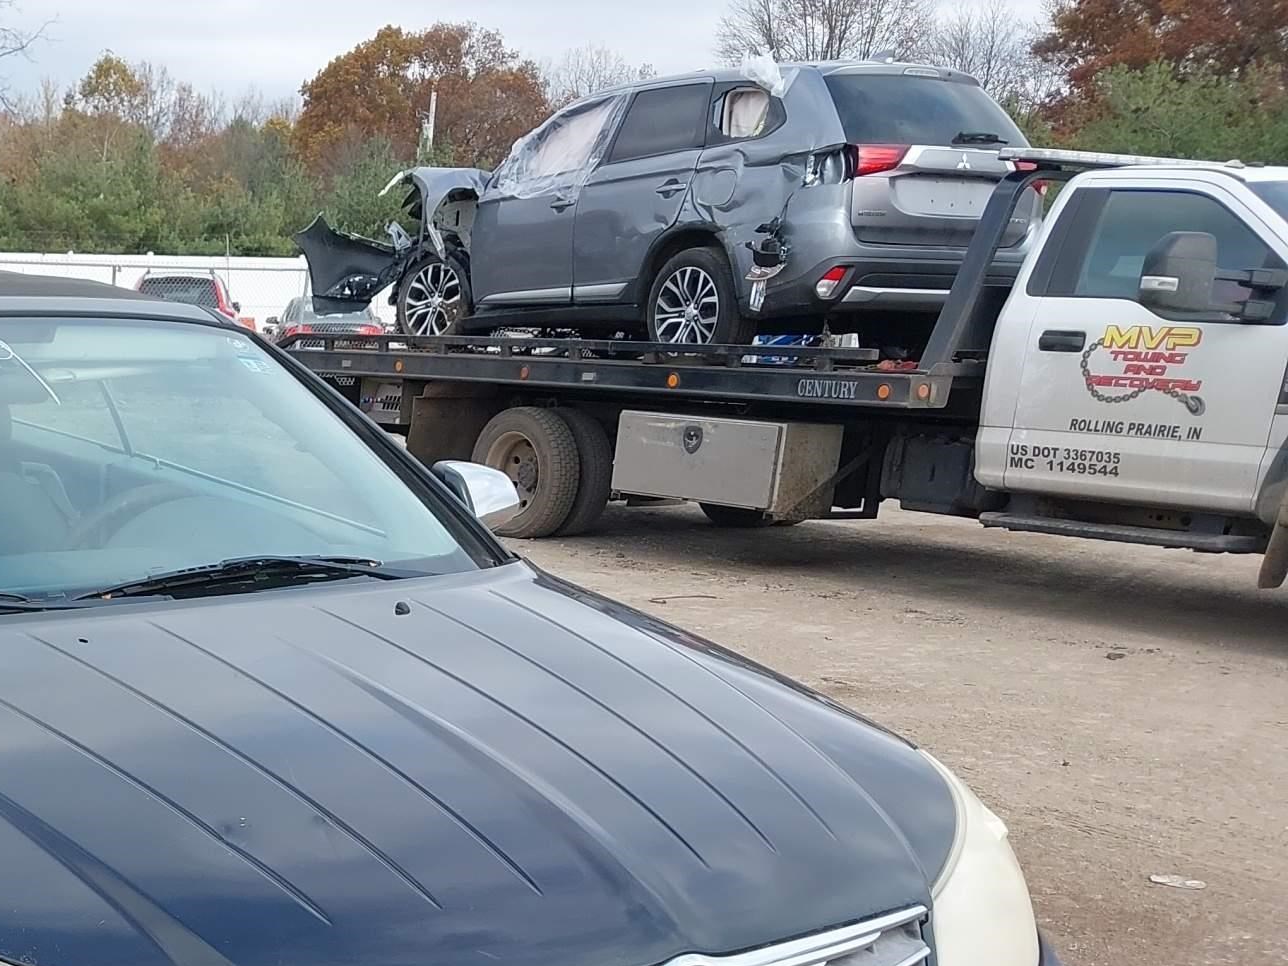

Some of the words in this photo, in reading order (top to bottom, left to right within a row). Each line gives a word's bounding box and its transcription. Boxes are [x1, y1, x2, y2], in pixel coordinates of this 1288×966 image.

[1103, 325, 1202, 350] MVP
[1110, 350, 1188, 364] TOWING
[1123, 363, 1167, 376] AND
[797, 379, 858, 399] CENTURY
[1087, 376, 1202, 391] RECOVERY
[1069, 418, 1124, 434] ROLLING
[1127, 422, 1182, 441] PRAIRIE,
[1186, 426, 1202, 440] IN
[1010, 443, 1028, 457] US
[1032, 446, 1060, 459] DOT
[1063, 448, 1121, 465] 3367035
[1010, 456, 1035, 470] MC
[1046, 460, 1120, 478] 1149544
